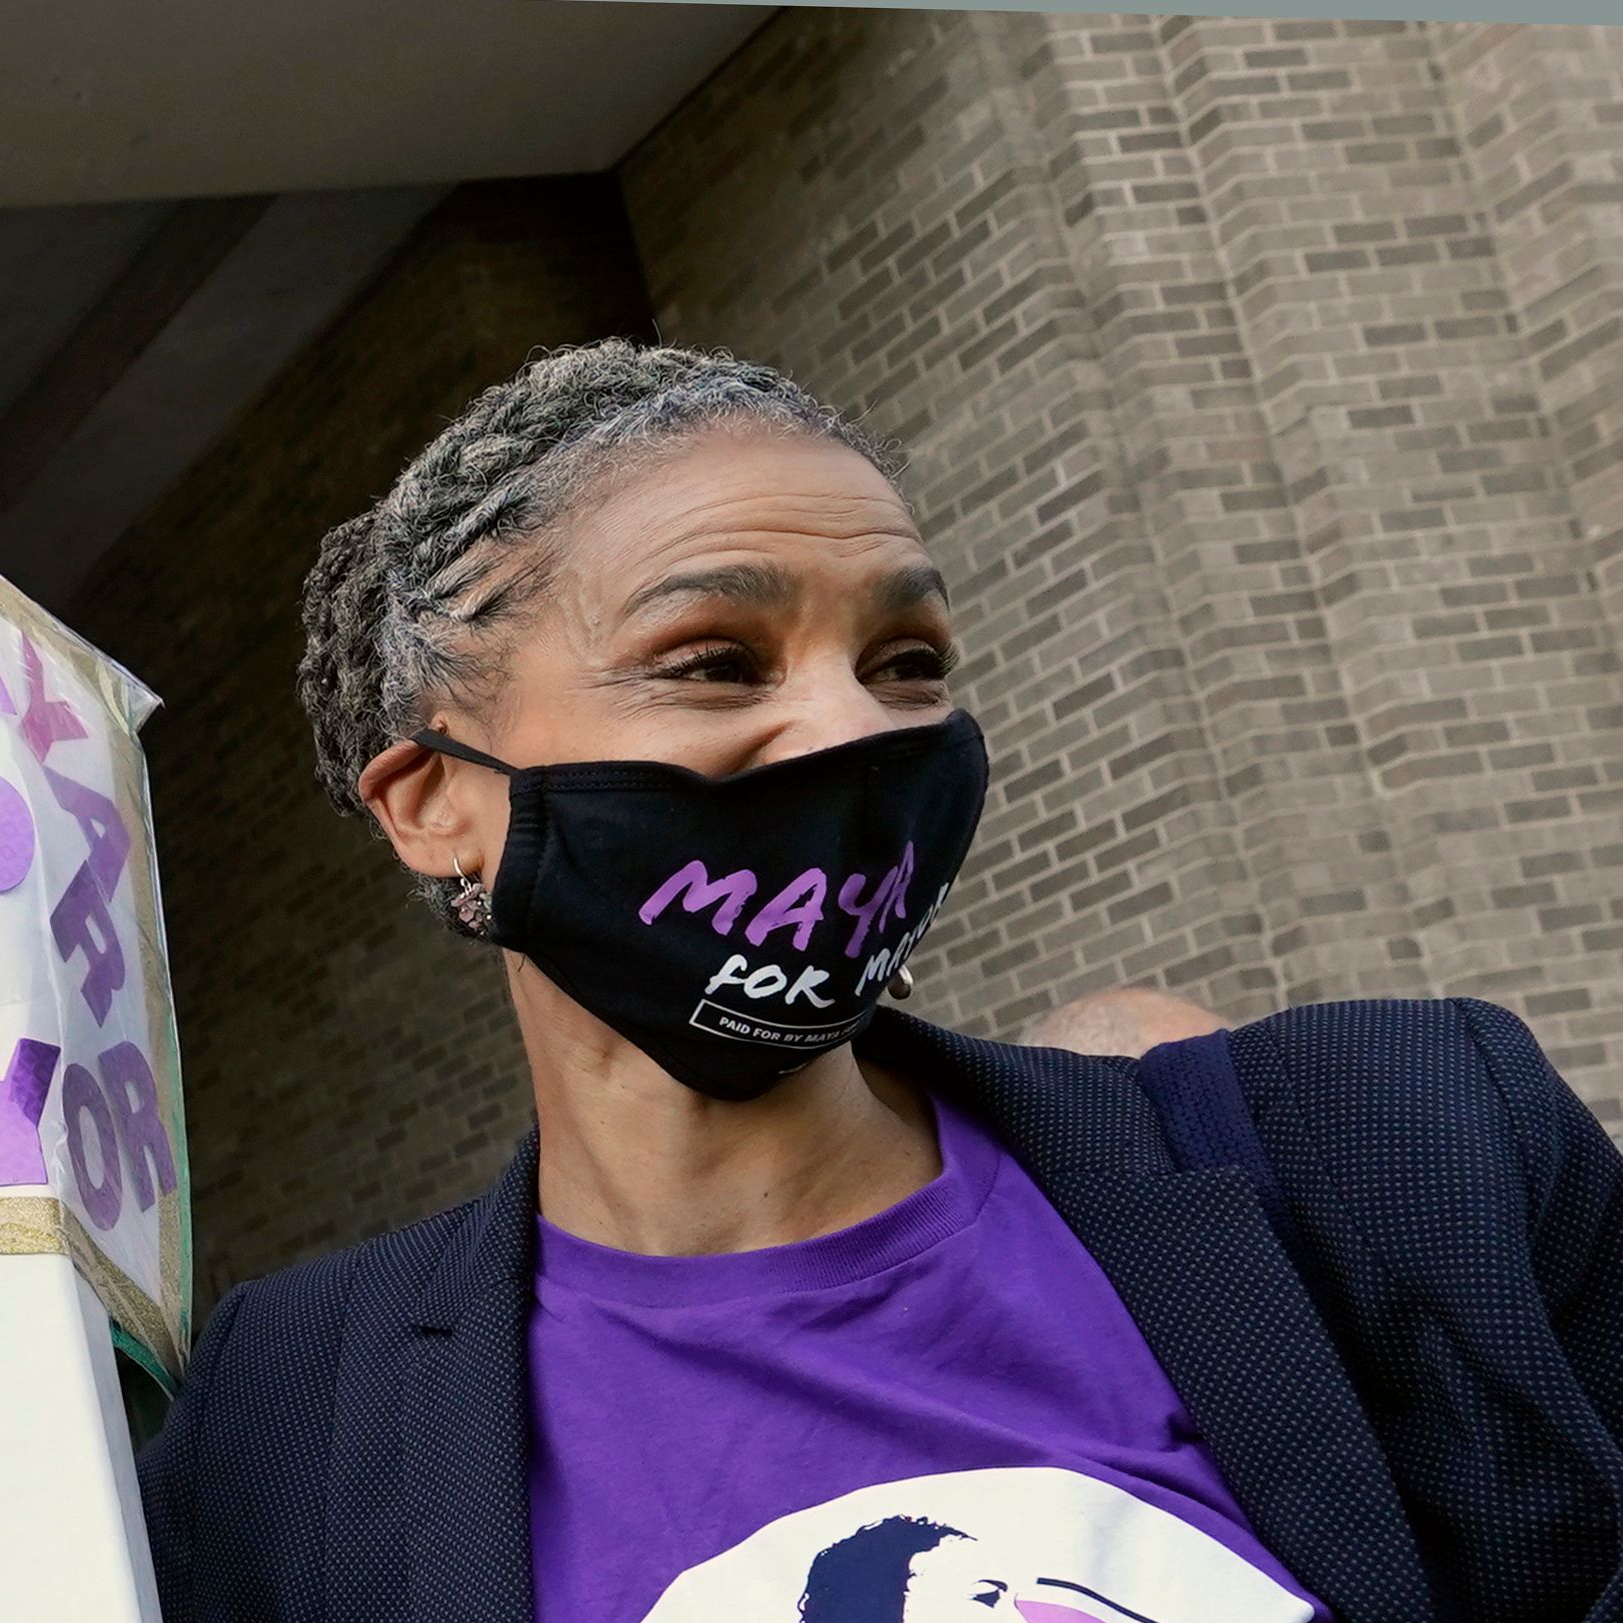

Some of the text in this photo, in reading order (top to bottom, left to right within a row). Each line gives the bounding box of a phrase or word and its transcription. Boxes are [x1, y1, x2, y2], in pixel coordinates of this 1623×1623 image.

[638, 840, 915, 958] MAYA
[705, 954, 835, 1008] FOR
[719, 1016, 751, 1034] PAID
[753, 1028, 781, 1041] FOR
[783, 1033, 804, 1042] BY
